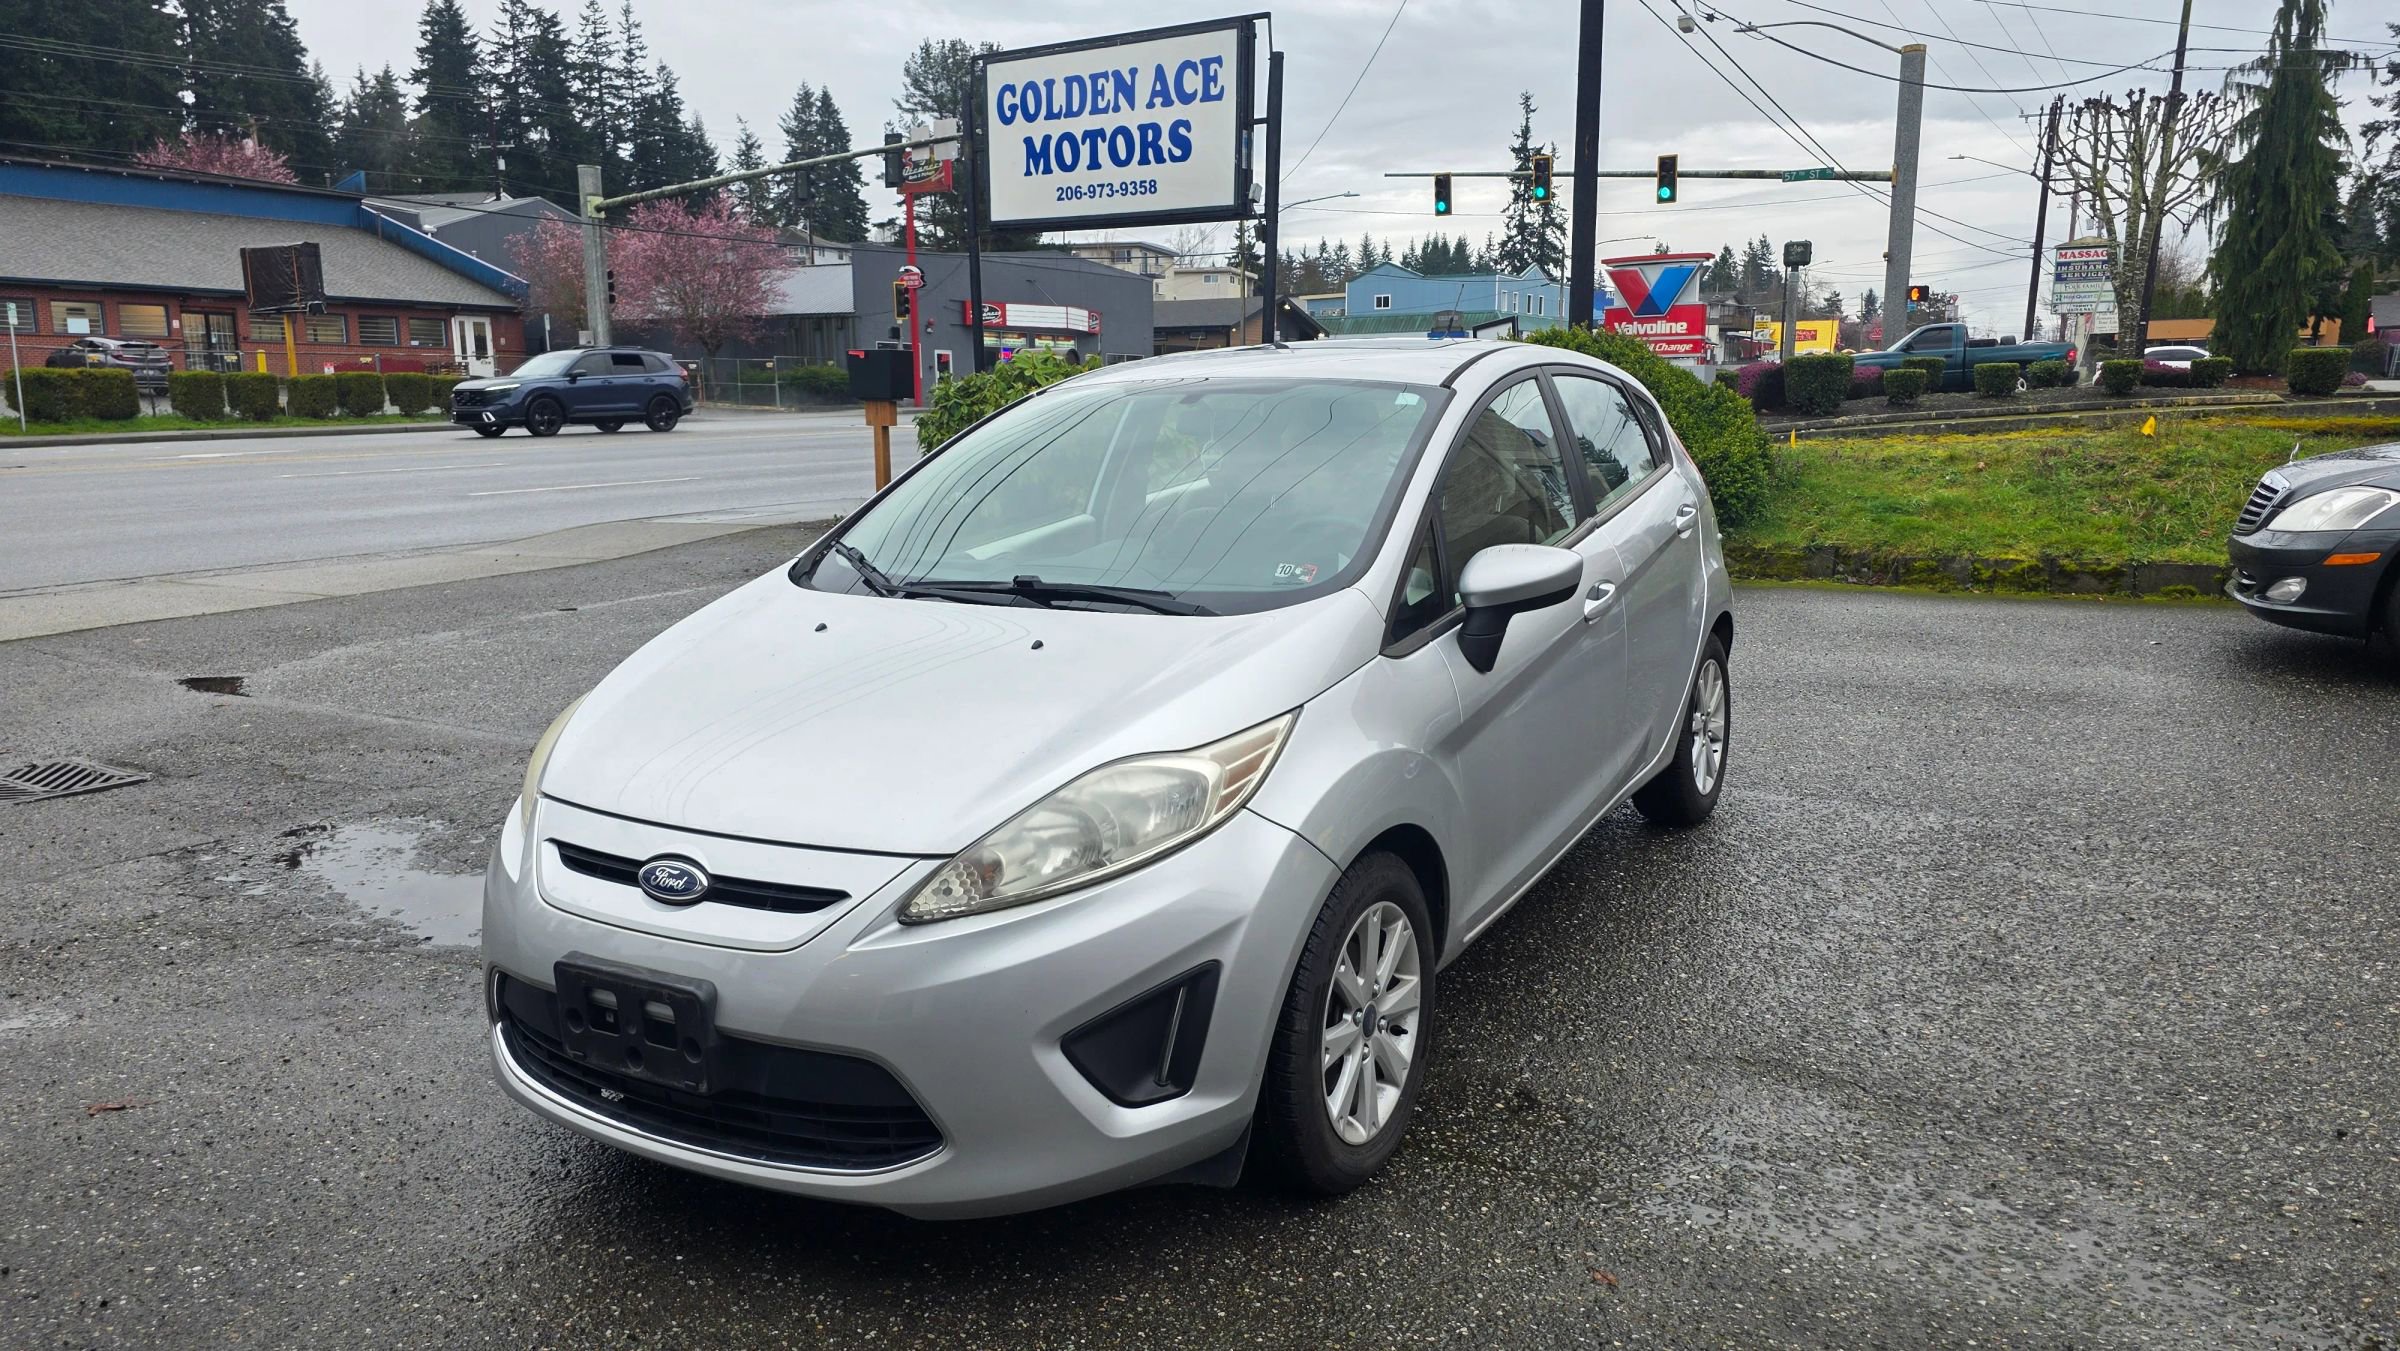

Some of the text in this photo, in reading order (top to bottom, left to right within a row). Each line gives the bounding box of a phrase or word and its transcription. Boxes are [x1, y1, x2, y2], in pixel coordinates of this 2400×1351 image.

[997, 55, 1225, 126] GOLDEN ACE
[1023, 119, 1193, 177] MOTORS
[1784, 172, 1797, 181] 57
[1809, 170, 1820, 179] ST
[1056, 179, 1158, 202] 206-973-9358
[2058, 250, 2109, 259] MASSAG
[1614, 320, 1688, 336] Valvoline
[1655, 342, 1694, 353] Change
[1279, 564, 1293, 575] 10
[650, 866, 688, 890] Ford
